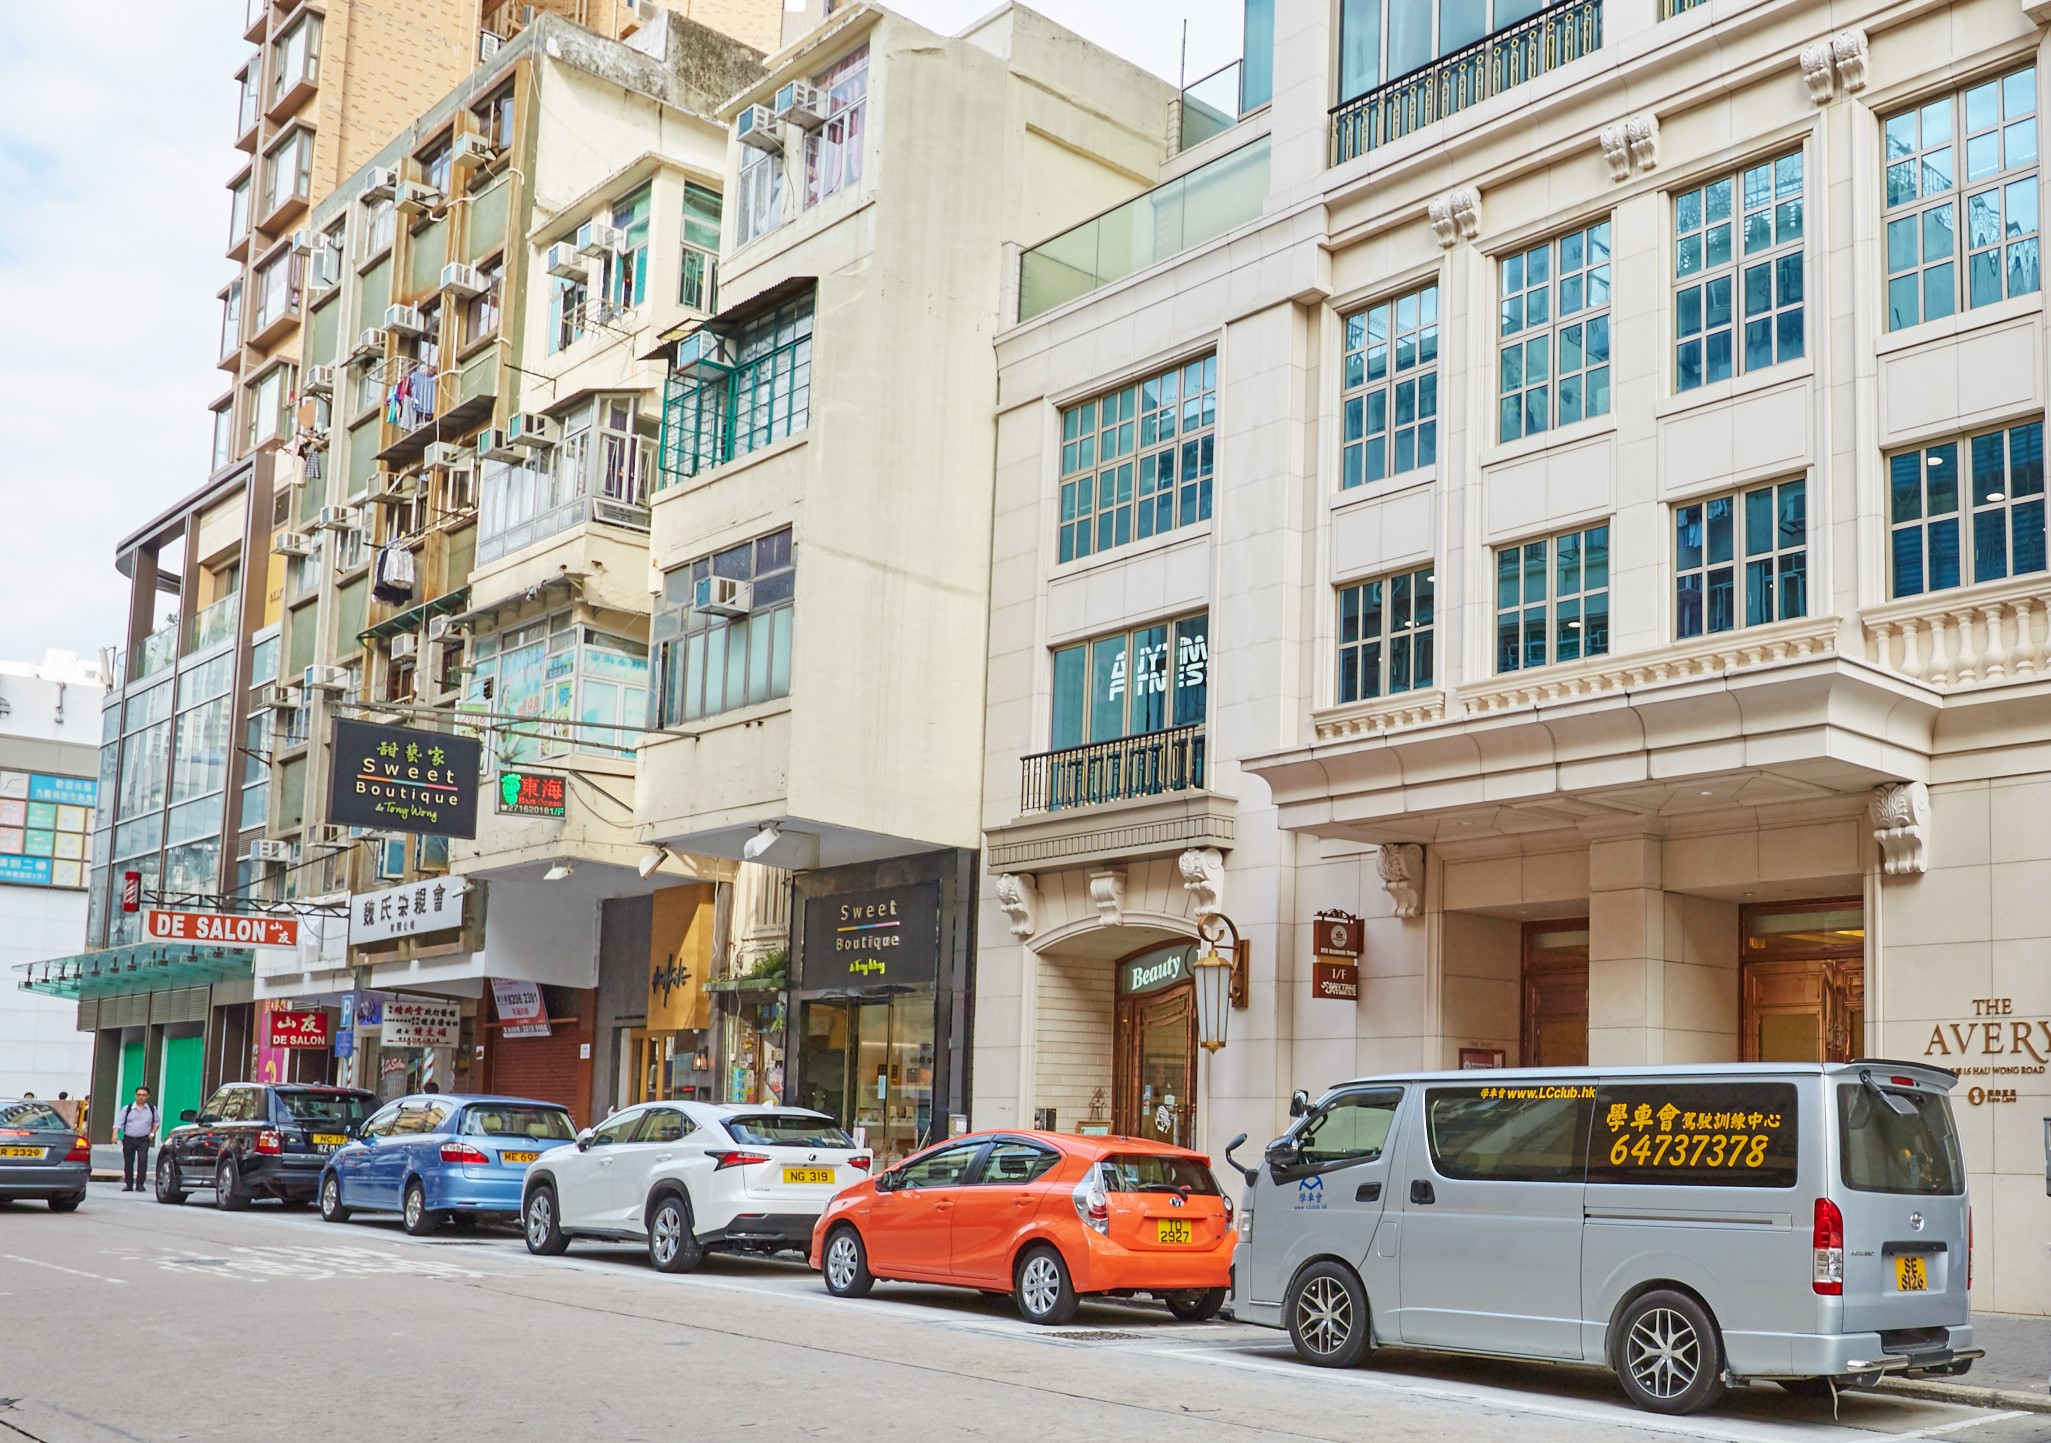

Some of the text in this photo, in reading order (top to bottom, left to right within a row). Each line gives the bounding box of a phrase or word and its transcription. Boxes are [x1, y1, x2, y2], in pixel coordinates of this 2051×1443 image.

[376, 741, 445, 766] 甜藝家
[362, 757, 454, 784] Sweet
[356, 781, 458, 806] Boutique
[520, 777, 562, 799] 東海
[384, 801, 409, 820] Tony
[410, 804, 438, 823] Wong
[363, 883, 446, 926] 魏氏宗親會
[840, 900, 897, 920] Sweet
[156, 913, 185, 937] DE
[196, 916, 266, 942] SALON
[836, 935, 900, 951] Boutique
[1131, 956, 1180, 990] Beauty
[1331, 968, 1347, 980] 1/F
[343, 999, 350, 1024] P
[1972, 998, 2012, 1016] THE
[277, 1014, 322, 1033] 山友
[272, 1035, 325, 1045] DE SALON
[1973, 1067, 1991, 1075] HAU
[1992, 1066, 2019, 1075] WONG
[2021, 1066, 2046, 1074] ROAD
[1480, 1086, 1596, 1099] 學車會 www.LCclub.hk
[1606, 1102, 1781, 1133] 學車會 駕駛訓練中心
[321, 1135, 332, 1143] NC
[13, 1149, 40, 1157] 2329
[504, 1152, 518, 1161] ME
[1610, 1134, 1769, 1168] 64737378
[790, 1171, 828, 1182] NG 319
[1299, 1192, 1323, 1205] 學車會
[1160, 1231, 1190, 1243] 2927
[1904, 1257, 1918, 1274] SE
